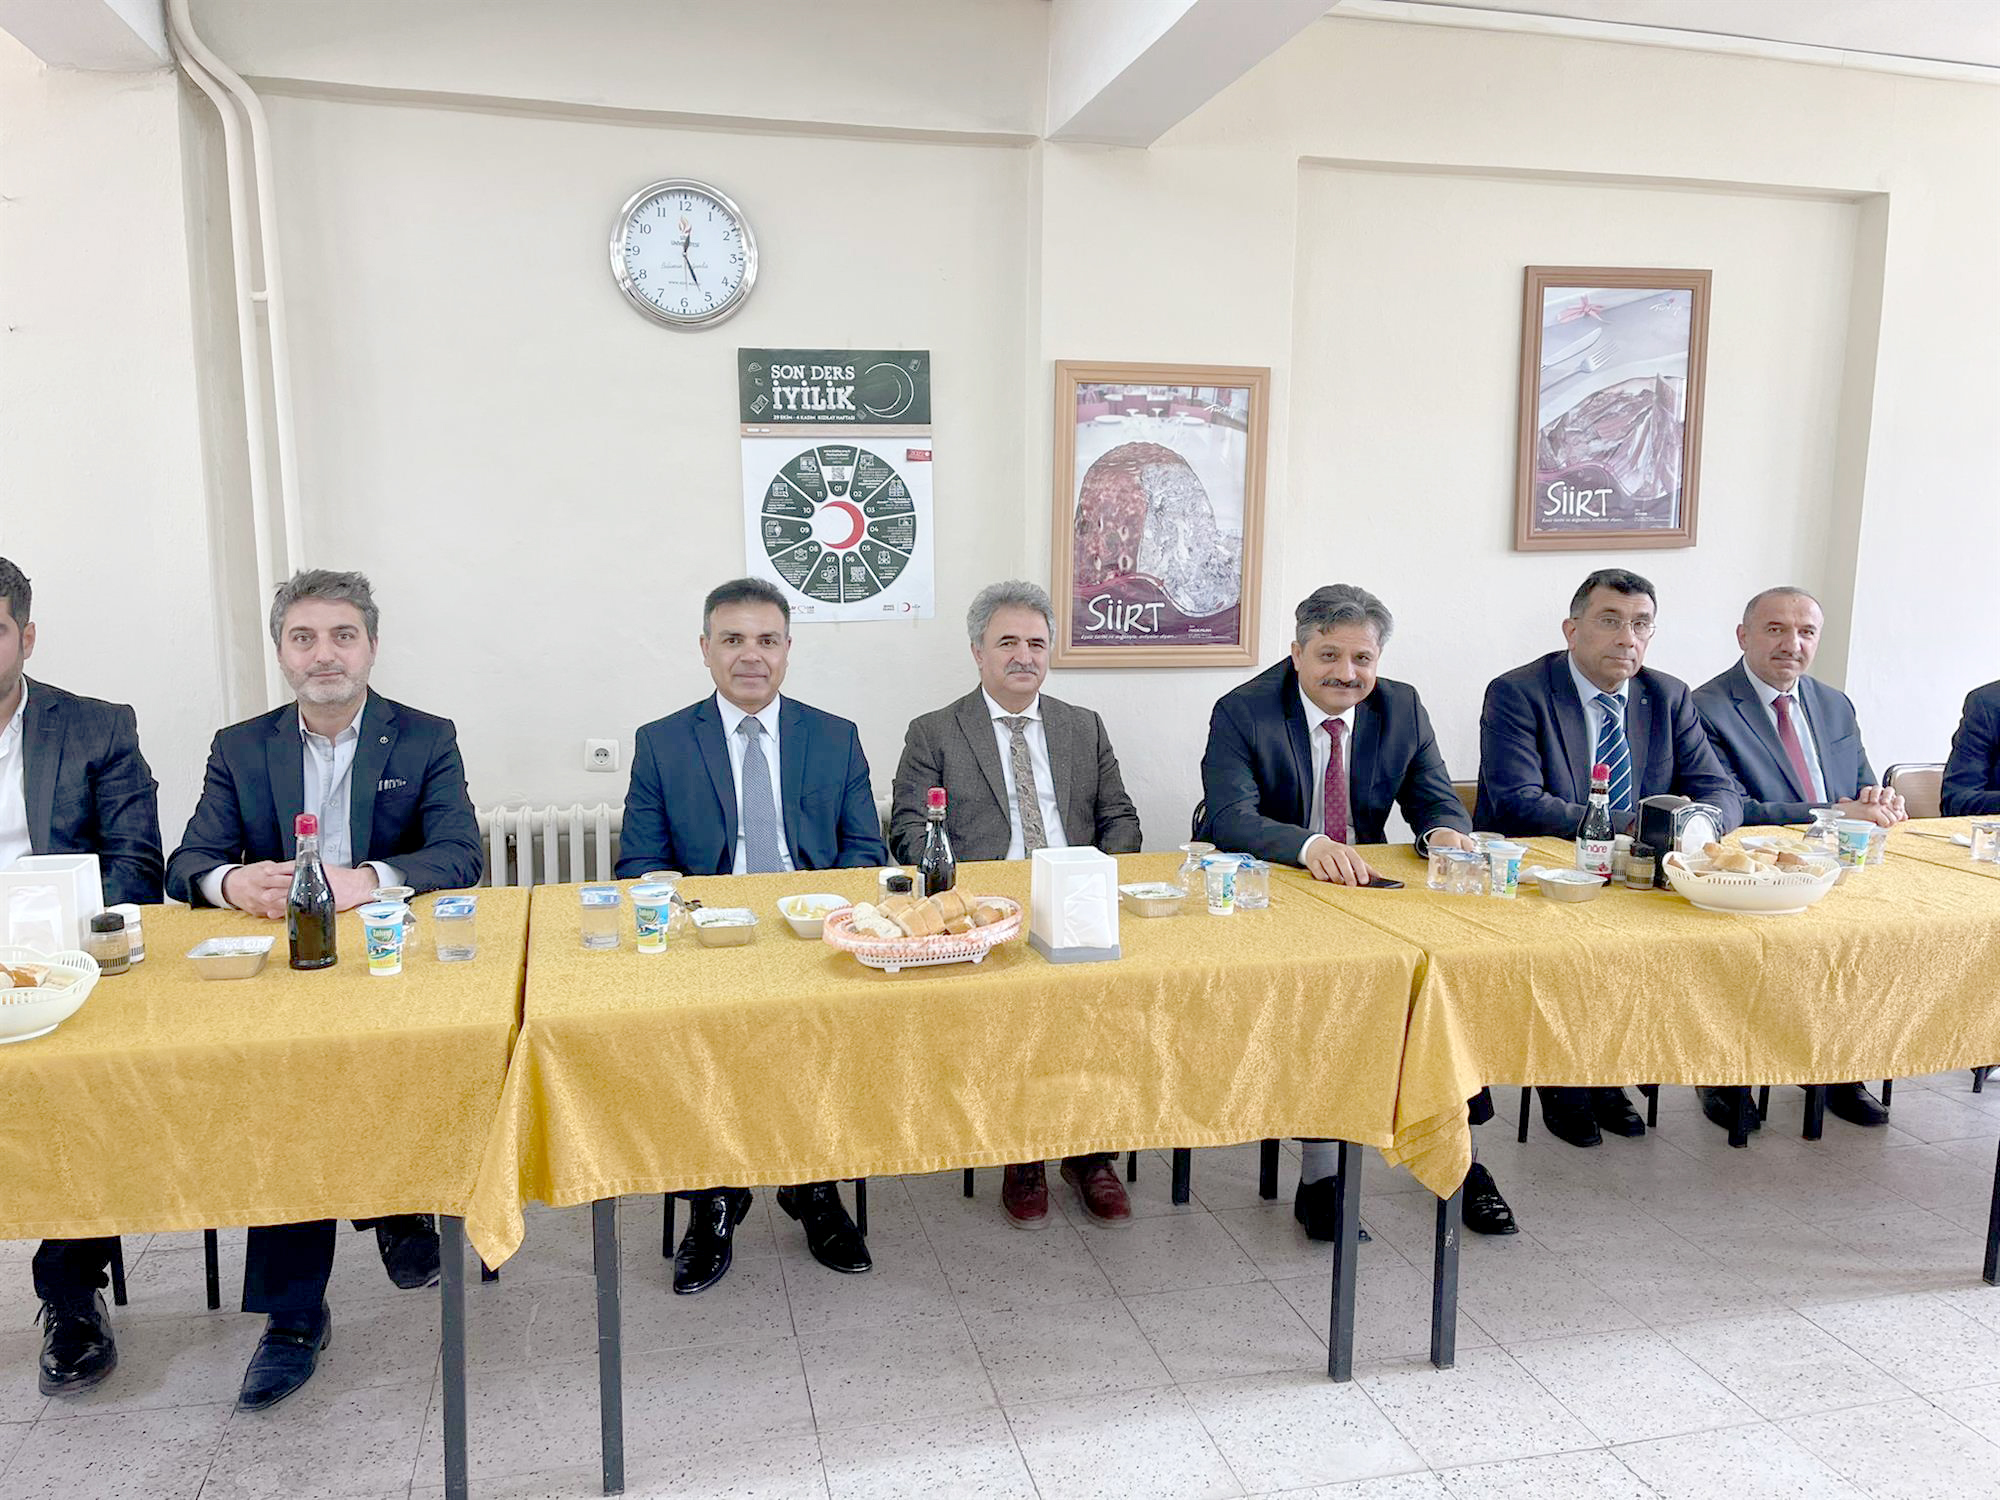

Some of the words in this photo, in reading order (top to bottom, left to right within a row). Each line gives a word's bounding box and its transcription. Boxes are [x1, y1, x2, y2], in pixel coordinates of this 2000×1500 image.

[679, 201, 692, 211] 12
[656, 207, 666, 218] 11
[708, 211, 713, 222] 1
[639, 223, 652, 234] 10
[722, 230, 730, 241] 2
[632, 245, 640, 256] 9
[729, 253, 737, 264] 3
[639, 269, 647, 279] 8
[721, 276, 729, 286] 4
[657, 288, 665, 298] 7
[704, 292, 712, 302] 5
[680, 297, 689, 308] 6
[770, 364, 806, 380] SON
[810, 365, 856, 380] DERS
[772, 379, 856, 411] İYİLİK
[799, 526, 810, 534] 09
